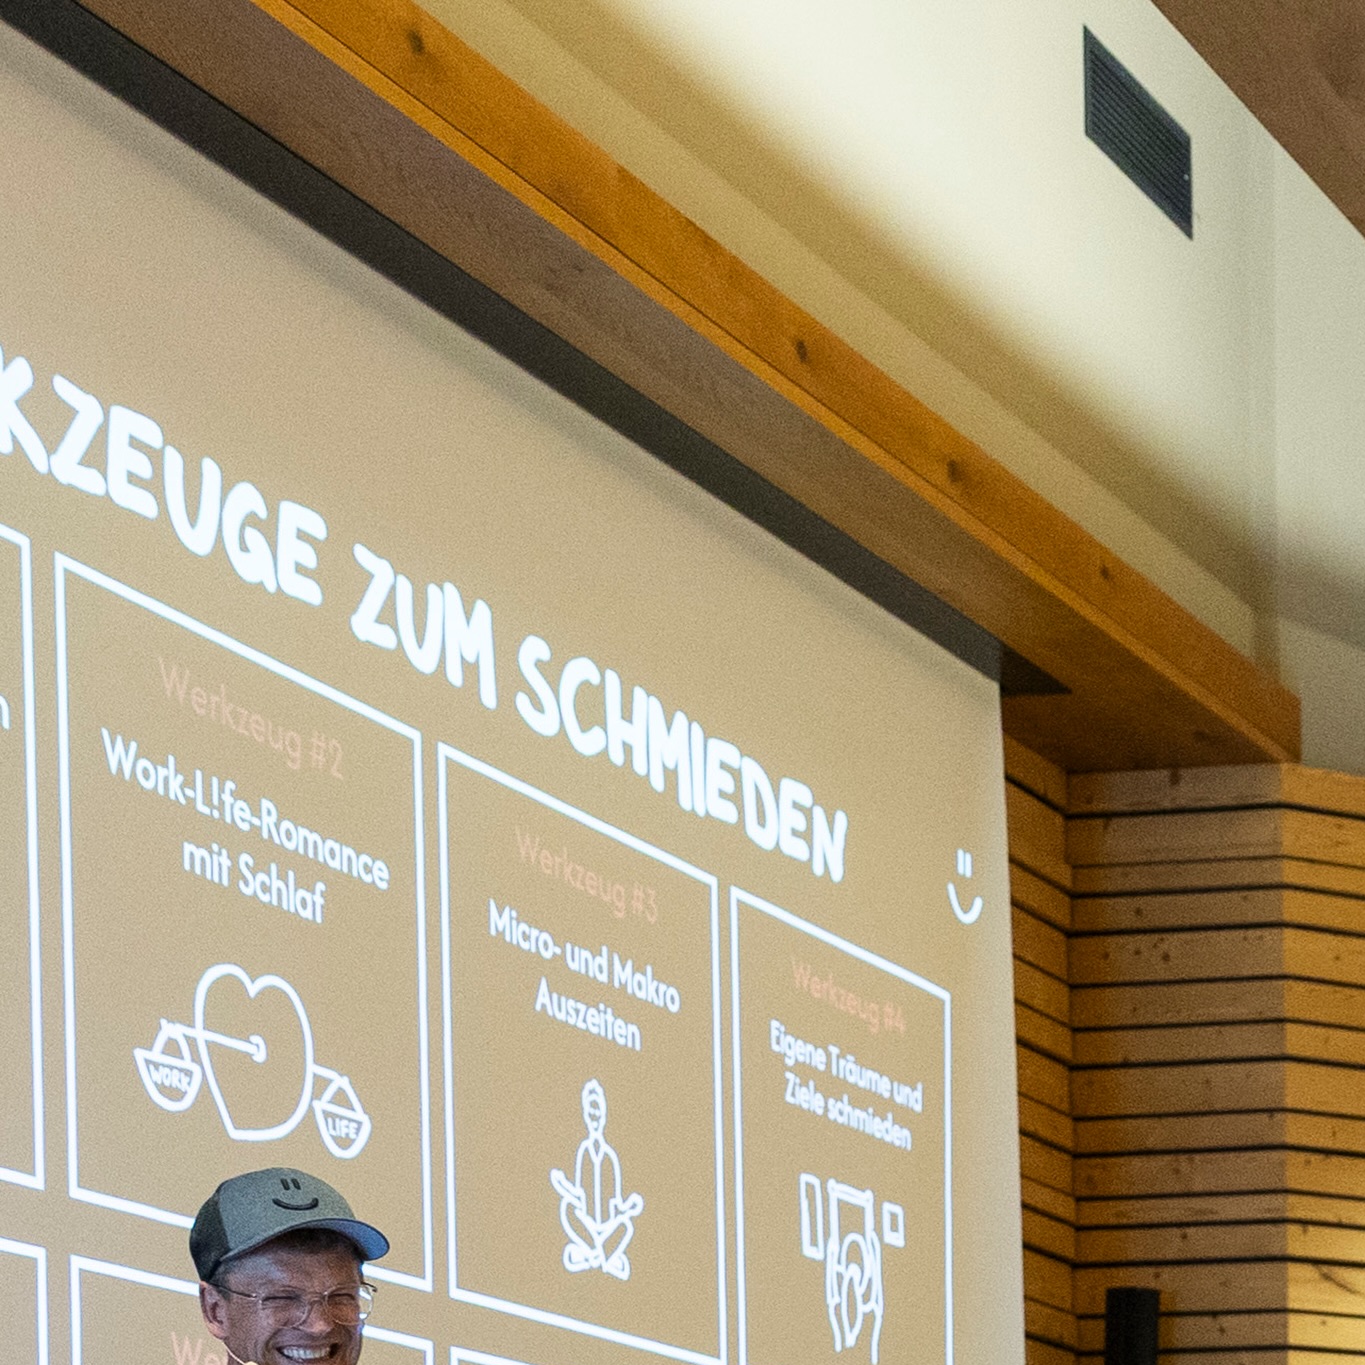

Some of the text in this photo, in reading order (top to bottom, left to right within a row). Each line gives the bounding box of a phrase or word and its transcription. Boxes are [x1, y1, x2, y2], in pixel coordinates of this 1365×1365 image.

[157, 655, 344, 781] Werkzeug #2
[350, 543, 498, 710] ZUM
[515, 634, 849, 883] SCHMIEDEN
[101, 727, 391, 891] Work-L!fe-Romance
[183, 841, 327, 924] mit Schlaf
[515, 826, 658, 925] Werkzeug #3
[488, 897, 681, 1013] Micro- und Makro
[792, 958, 881, 1034] Werkzeug
[535, 976, 642, 1051] Auszeiten
[149, 1063, 191, 1092] WORK
[770, 1018, 923, 1113] Eigene Träume und
[328, 1117, 358, 1140] LIFE
[785, 1070, 912, 1151] Ziele schmieden
